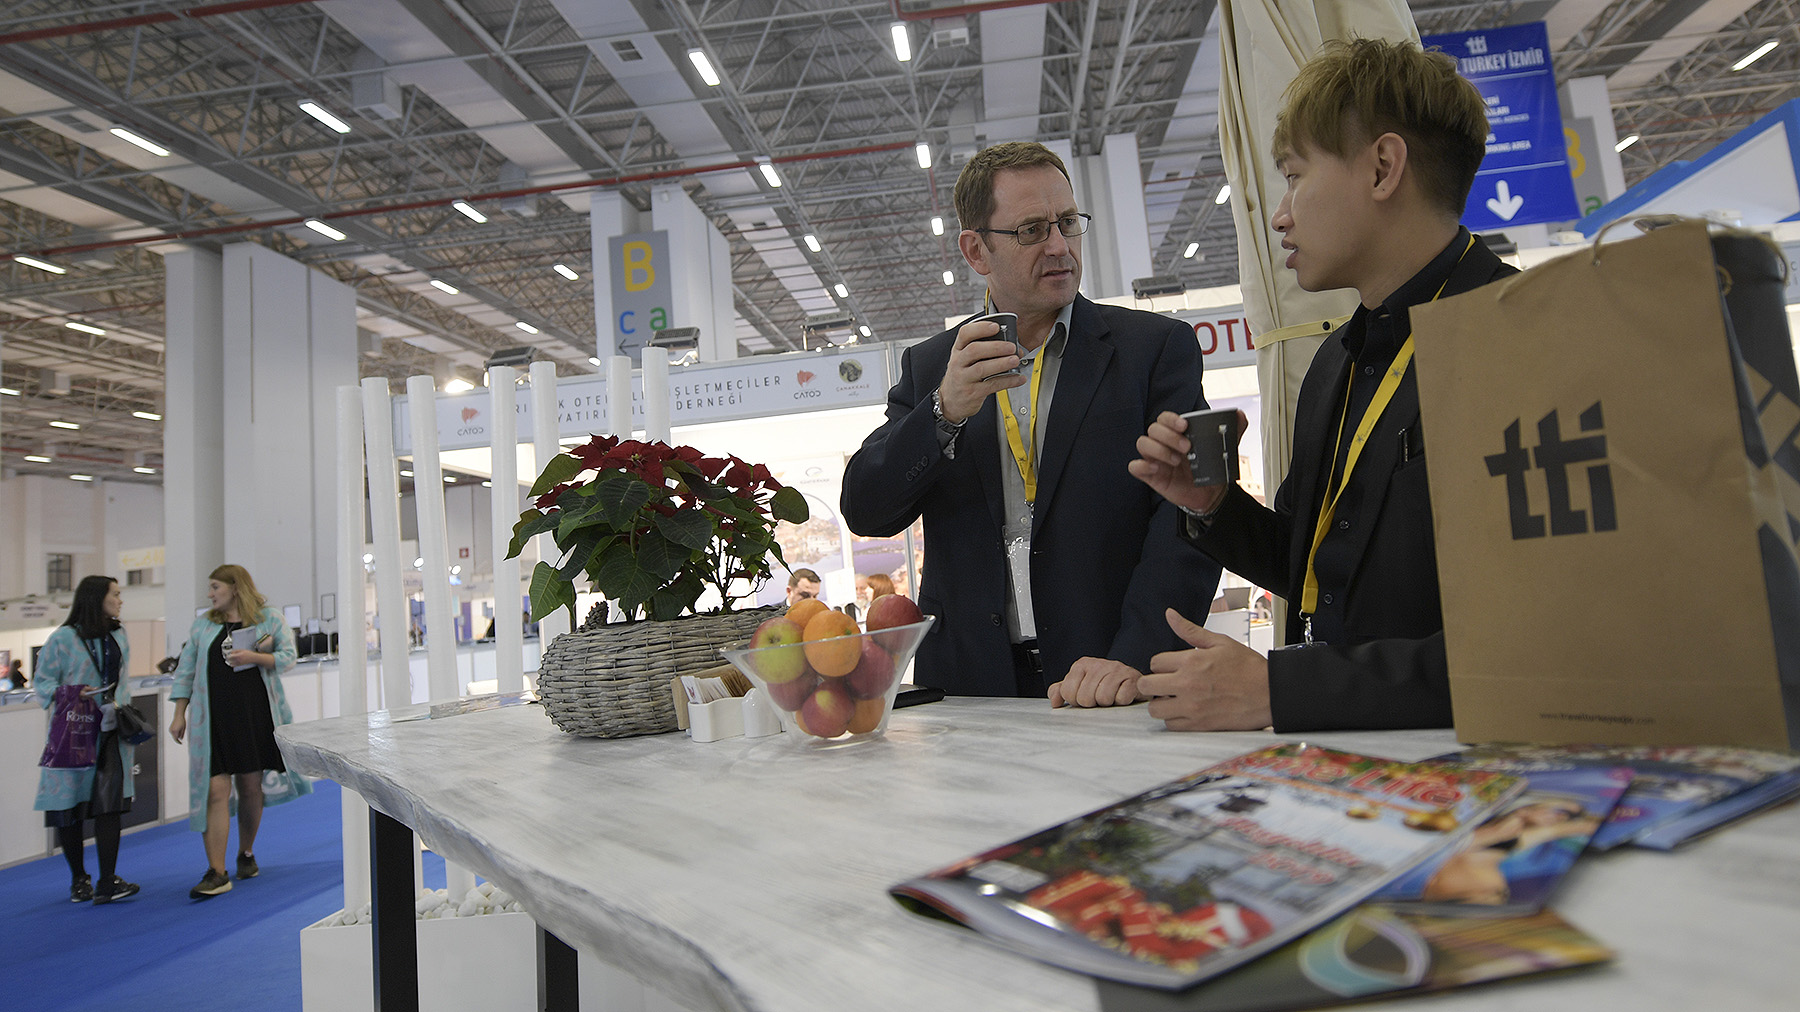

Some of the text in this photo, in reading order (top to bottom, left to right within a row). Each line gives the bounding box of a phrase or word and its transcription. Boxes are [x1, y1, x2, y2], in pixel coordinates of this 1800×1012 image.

[1461, 53, 1507, 74] TURKEY
[1507, 47, 1544, 69] İZMİR
[622, 240, 656, 292] B
[673, 375, 781, 399] ŞLETMECİLER
[676, 392, 743, 411] DERNEĞİ
[1483, 400, 1618, 541] tti
